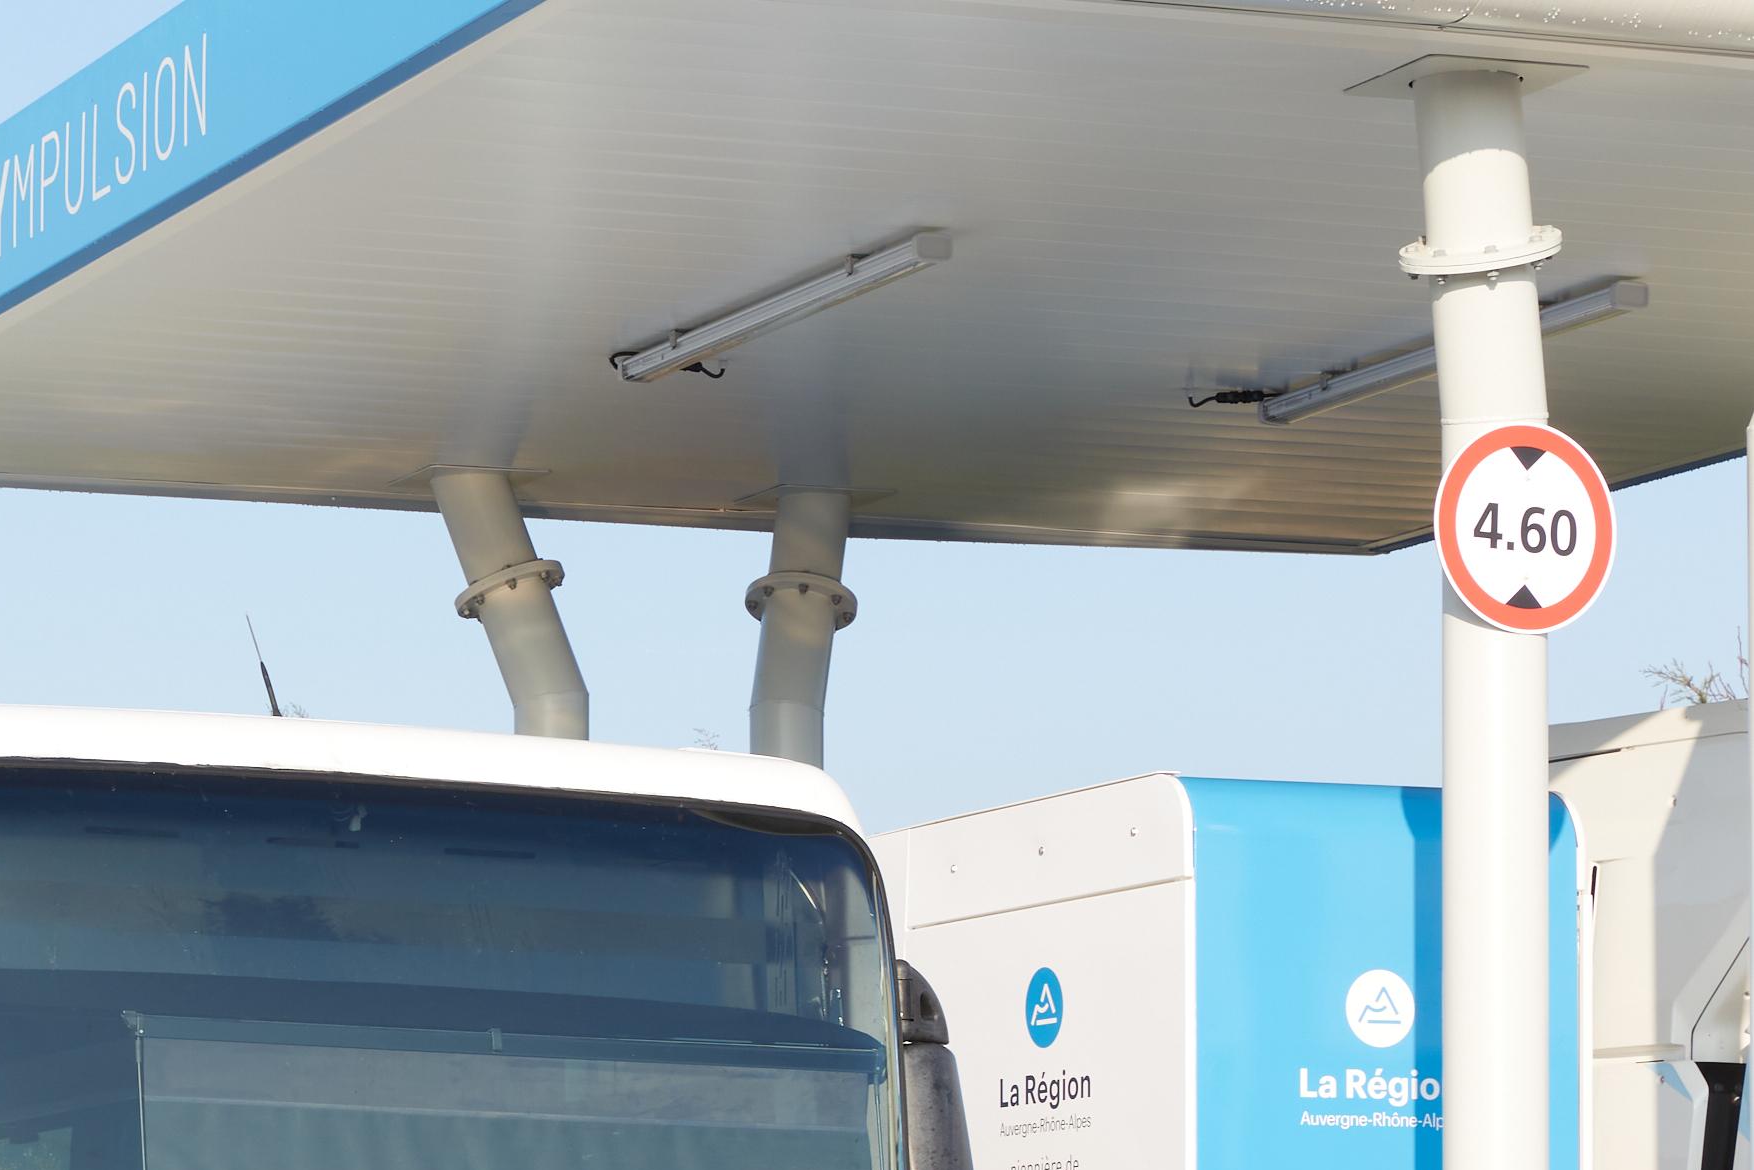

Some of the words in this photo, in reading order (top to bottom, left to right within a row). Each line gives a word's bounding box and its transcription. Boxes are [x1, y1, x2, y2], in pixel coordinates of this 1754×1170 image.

[1473, 502, 1577, 557] 4.60
[999, 1078, 1019, 1108] La
[1025, 1069, 1091, 1109] Région
[1299, 1067, 1337, 1098] La
[1345, 1068, 1441, 1107] Régio
[999, 1114, 1092, 1138] Auvergne-Rhône-Alpes
[1300, 1110, 1444, 1131] Auvergne-Rhône-Alp
